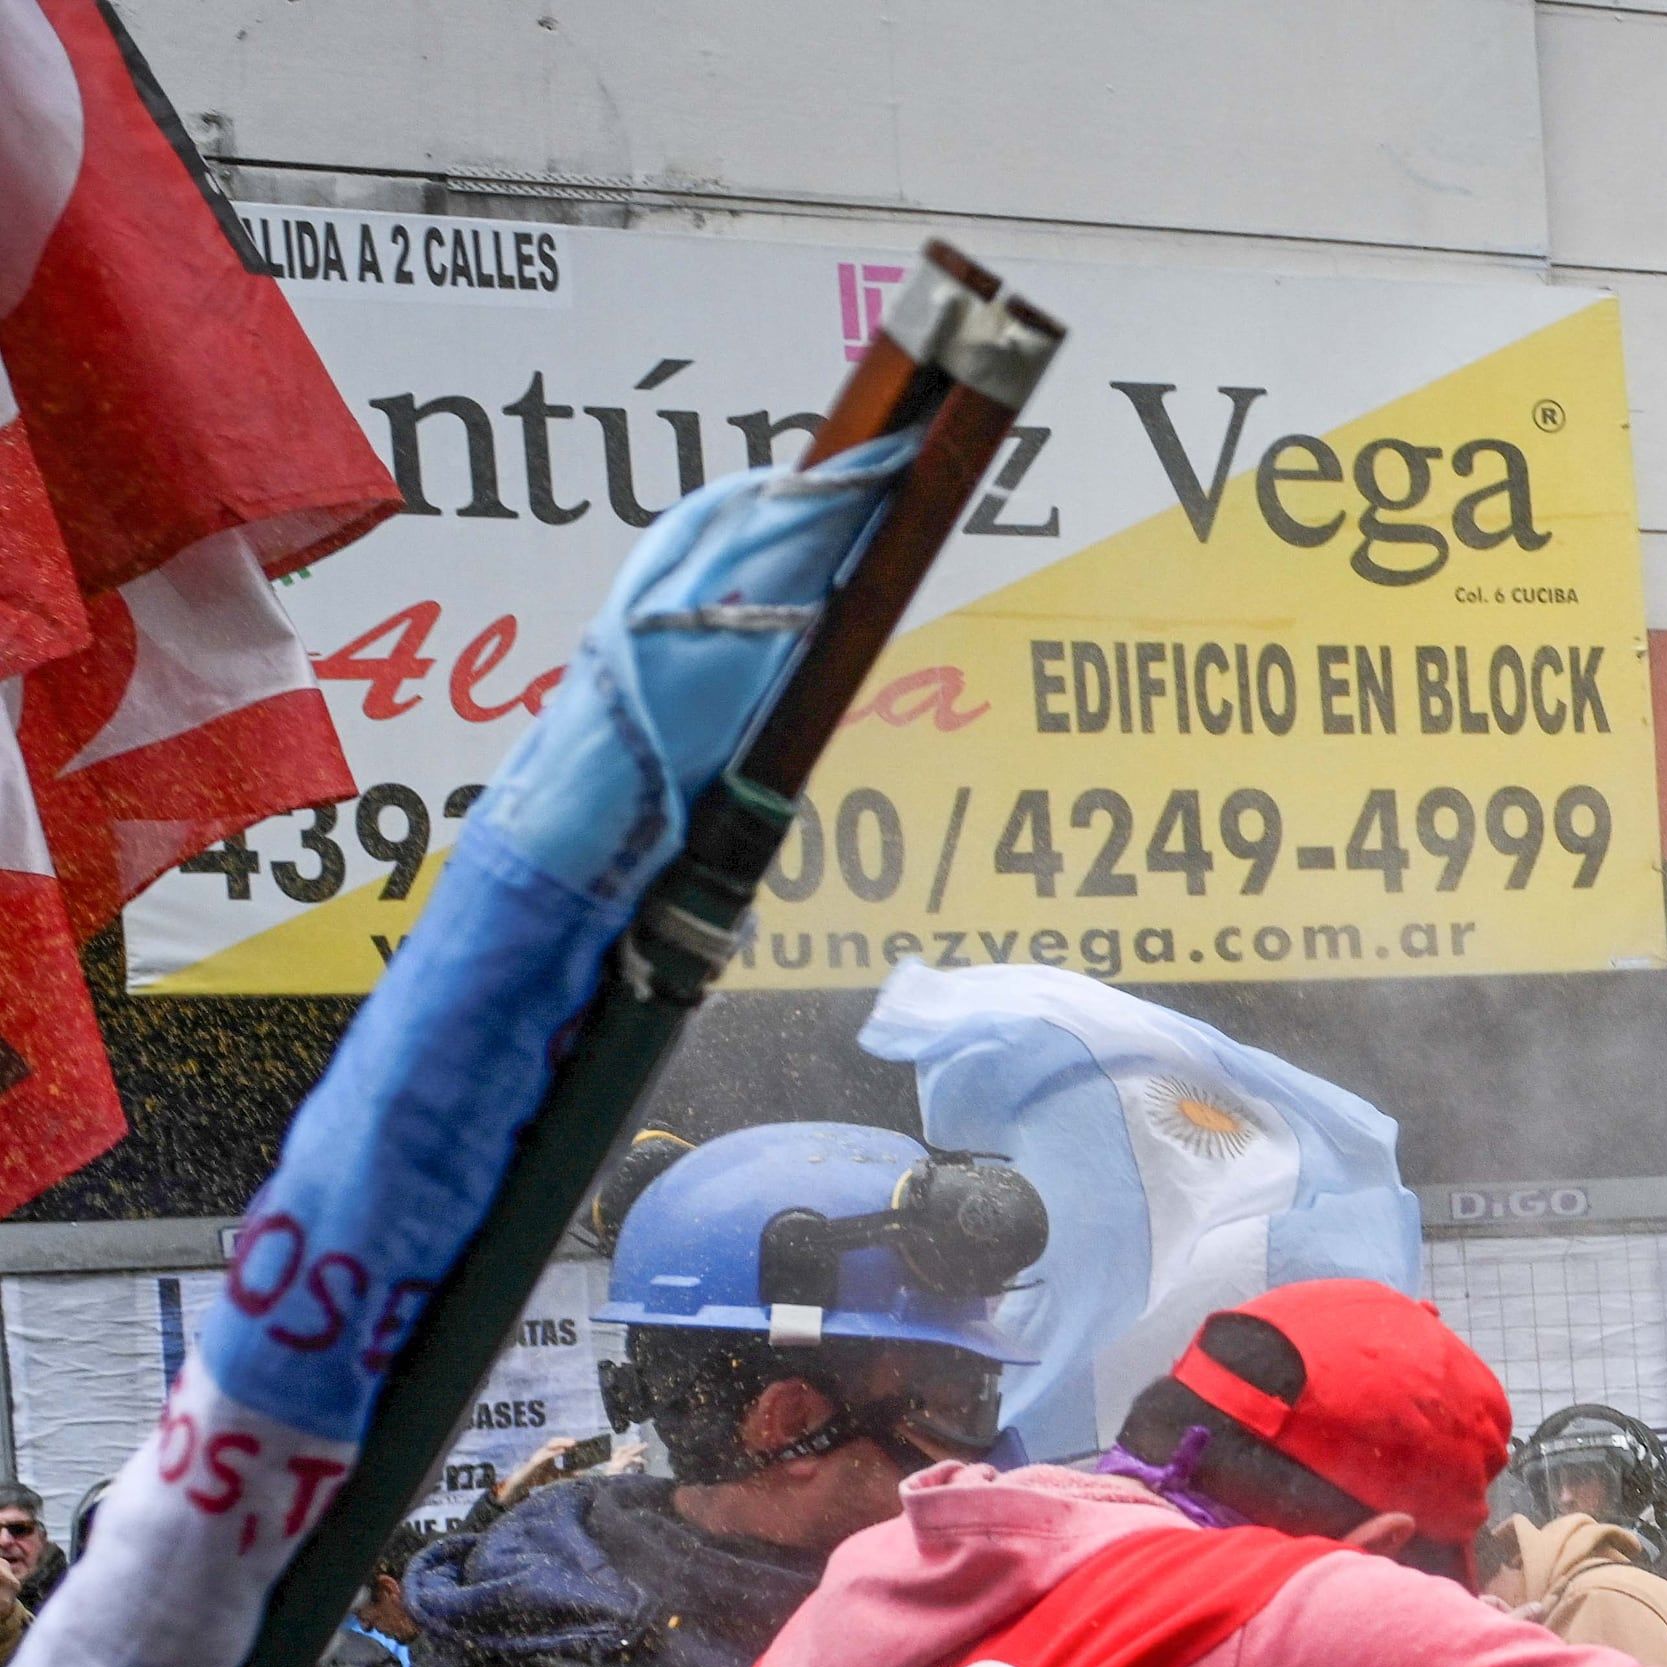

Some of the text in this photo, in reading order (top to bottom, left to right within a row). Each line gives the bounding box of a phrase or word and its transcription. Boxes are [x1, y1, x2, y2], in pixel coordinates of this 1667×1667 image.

[358, 223, 384, 284] A
[390, 224, 415, 285] 2
[424, 226, 561, 293] CALLES
[1110, 380, 1553, 587] Vega
[1455, 586, 1580, 605] Col. 6 CUCIBA
[1030, 639, 1297, 736] EDIFICIO
[1316, 644, 1398, 736] EN
[1416, 643, 1612, 737] BLOCK
[470, 1399, 547, 1430] ASES
